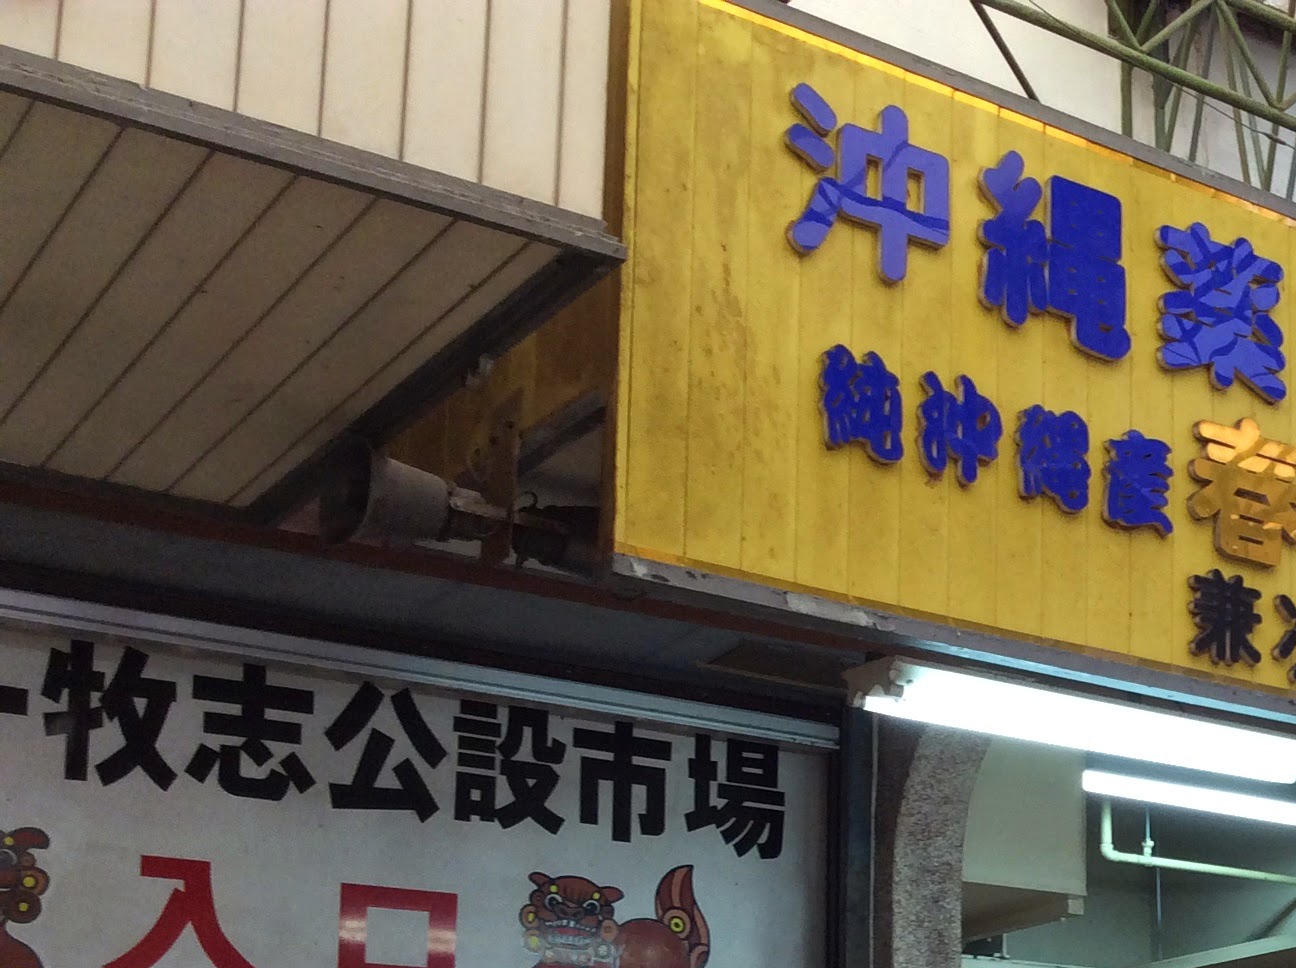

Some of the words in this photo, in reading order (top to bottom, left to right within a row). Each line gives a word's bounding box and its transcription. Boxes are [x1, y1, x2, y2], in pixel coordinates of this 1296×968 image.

[0, 640, 786, 859] 牧志公設市場
